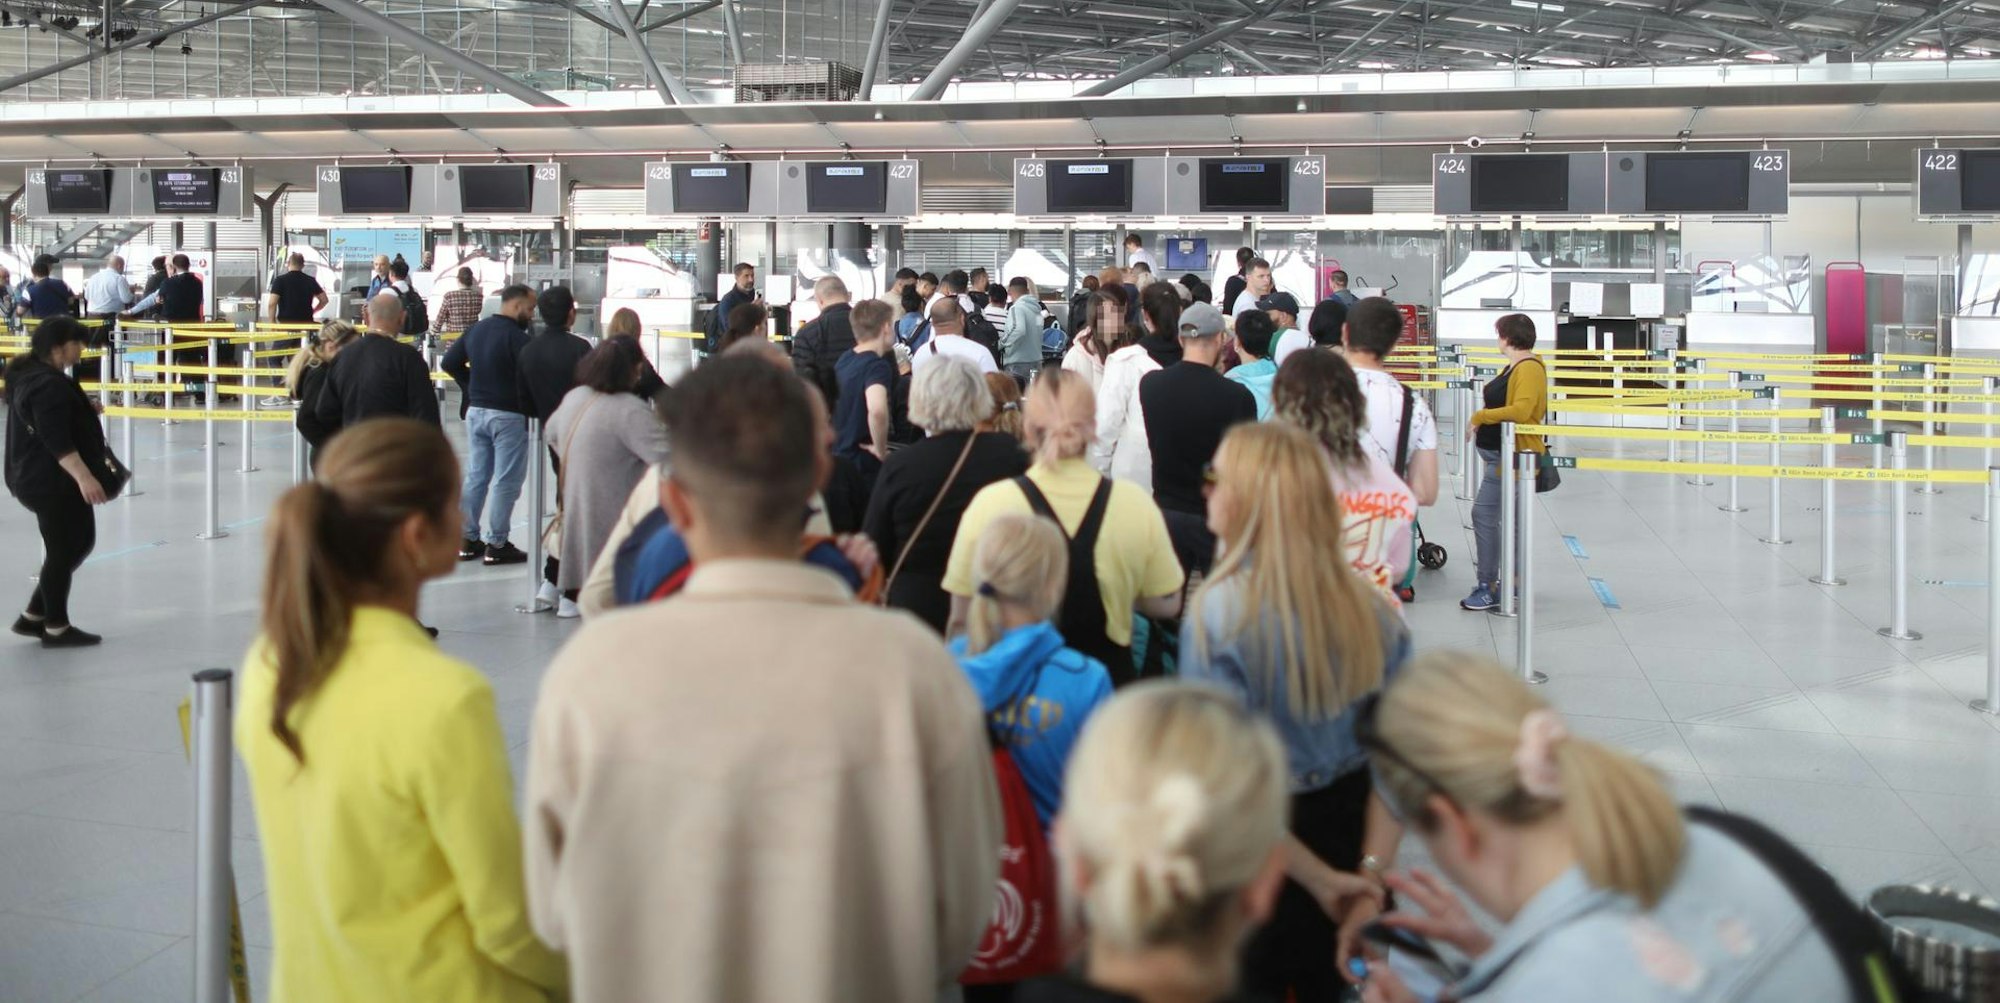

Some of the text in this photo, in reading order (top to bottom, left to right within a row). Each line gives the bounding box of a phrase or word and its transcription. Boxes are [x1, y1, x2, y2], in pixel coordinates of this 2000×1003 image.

[1293, 161, 1320, 175] 425
[1439, 159, 1467, 174] 424
[1753, 156, 1784, 171] 423
[1925, 154, 1957, 170] 422
[321, 170, 340, 182] 430
[535, 168, 556, 181] 429
[649, 167, 671, 180] 428
[890, 165, 913, 179] 427
[1019, 163, 1044, 177] 426
[29, 173, 46, 185] 432
[220, 172, 239, 183] 431
